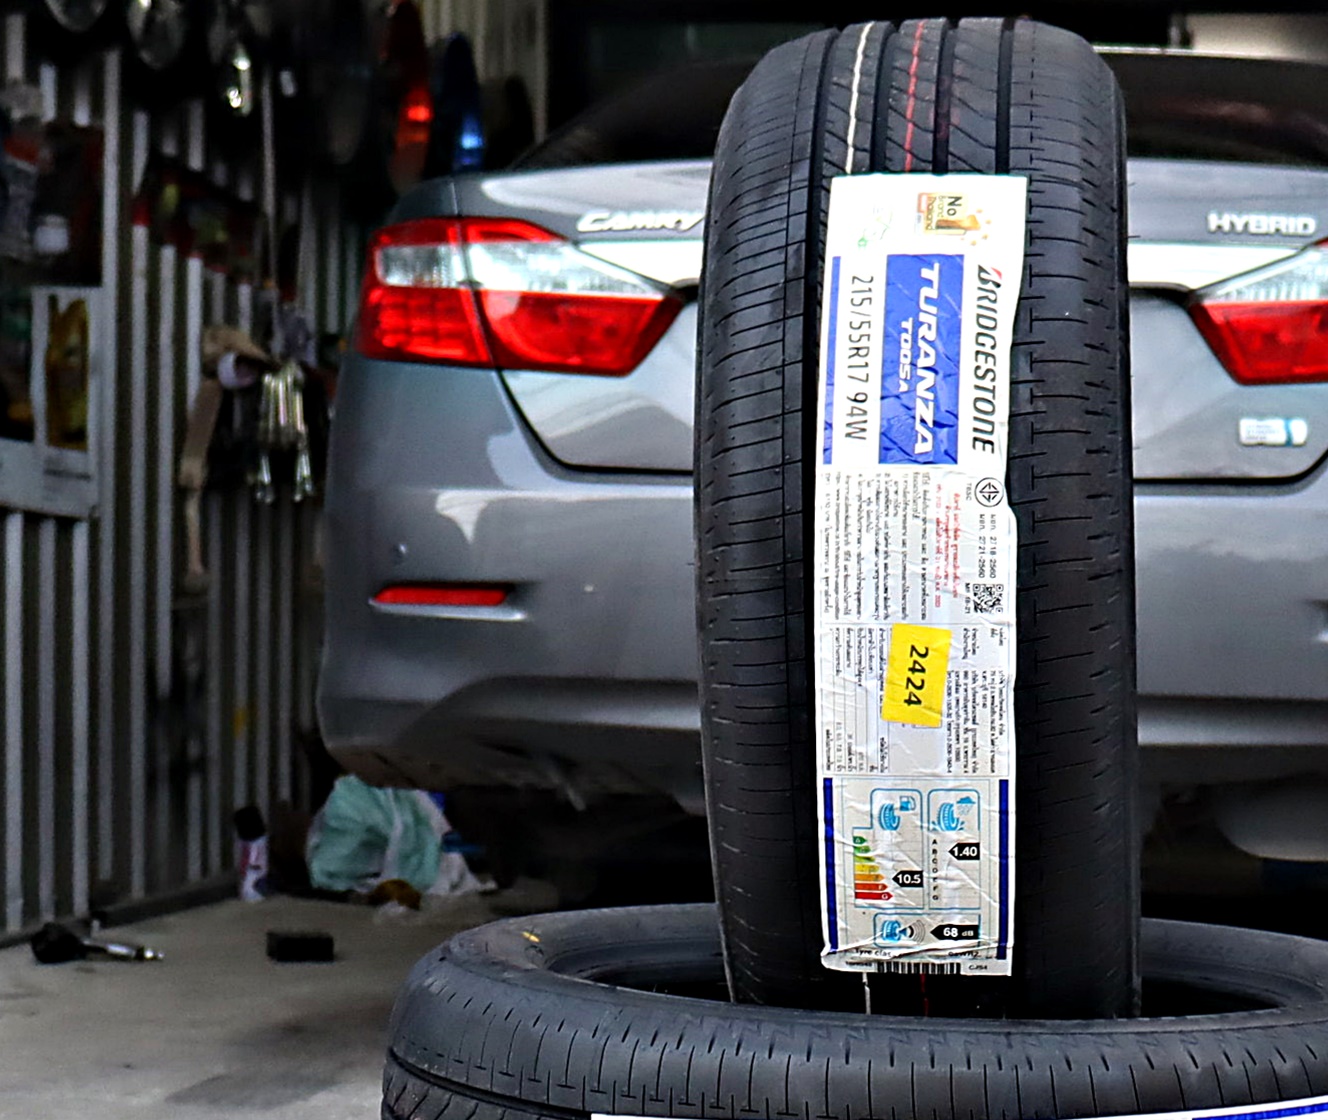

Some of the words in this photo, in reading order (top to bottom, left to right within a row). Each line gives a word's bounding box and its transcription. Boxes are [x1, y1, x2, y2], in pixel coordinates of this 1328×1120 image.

[576, 210, 703, 235] CAMRY
[1207, 211, 1317, 236] HYBRID
[846, 275, 874, 384] 215/55R17
[913, 262, 940, 455] TURANZA
[972, 264, 1003, 454] BRIDGESTONE
[845, 392, 868, 441] 94W
[903, 644, 930, 707] 2424
[952, 846, 978, 858] 1.40
[896, 873, 922, 885] 10.5
[943, 927, 959, 938] 68
